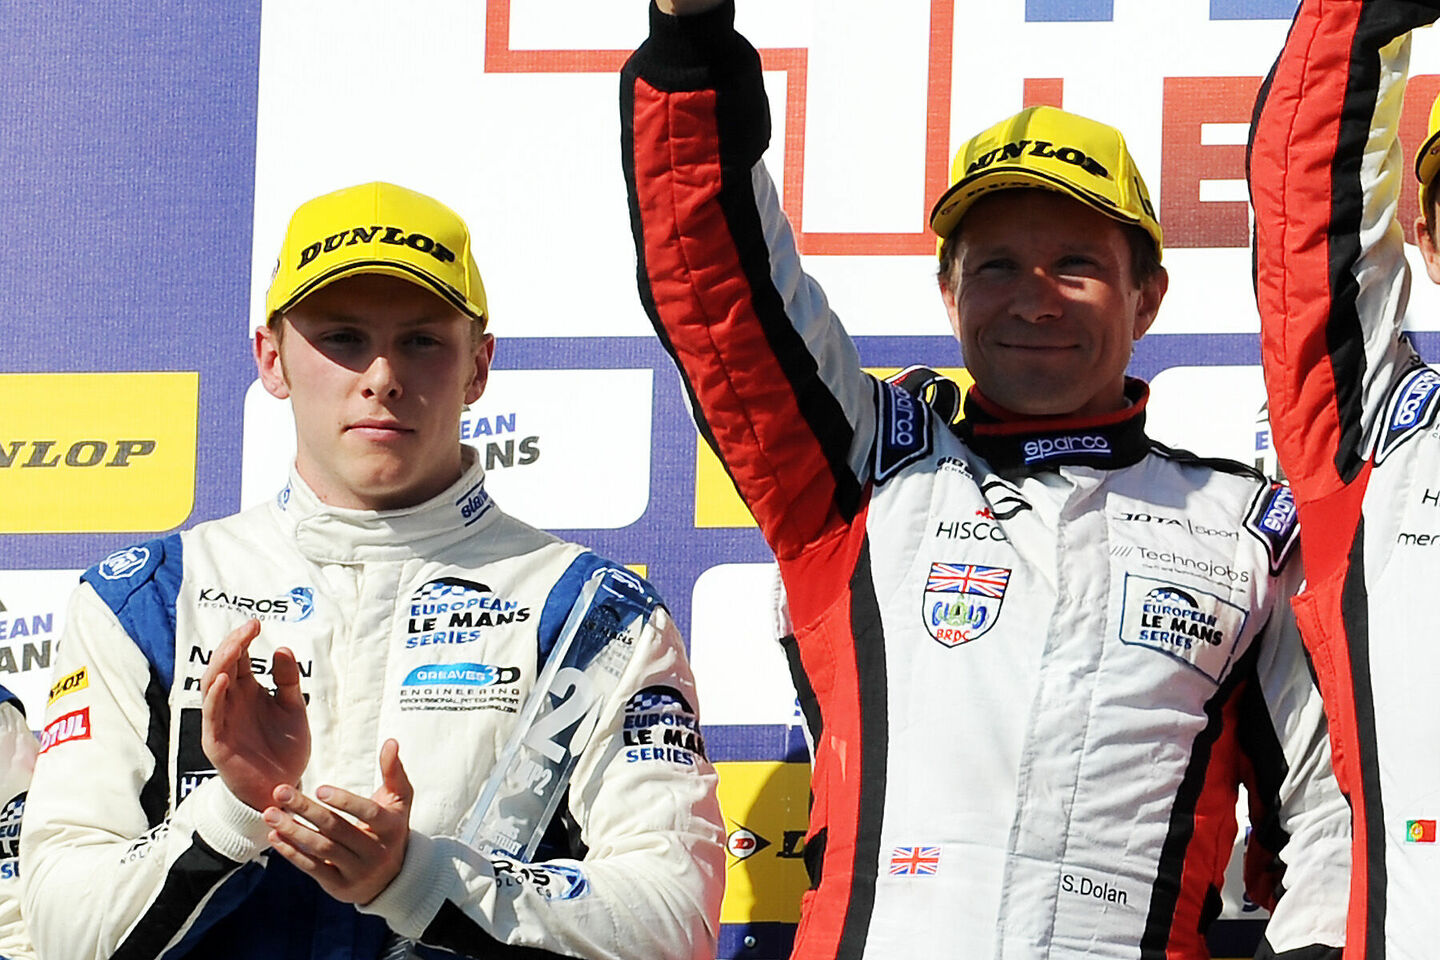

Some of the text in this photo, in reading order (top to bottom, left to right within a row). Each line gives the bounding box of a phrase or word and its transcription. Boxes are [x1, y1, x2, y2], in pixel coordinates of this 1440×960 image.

[965, 140, 1110, 178] DUNLOP
[297, 226, 456, 270] DUNLOP
[0, 441, 156, 468] NLOP
[486, 435, 540, 470] NS
[1023, 436, 1109, 459] sparco
[936, 521, 1010, 544] HISCO
[1137, 546, 1249, 583] Technojobs
[200, 589, 288, 613] KAIROS
[411, 597, 518, 617] EUROPEAN
[408, 607, 531, 634] LE MANS
[1143, 603, 1218, 628] EUROPEAN
[405, 630, 481, 649] SERIES
[936, 628, 971, 643] BRDC
[1139, 629, 1193, 649] SERIES
[1141, 614, 1223, 646] LE MANS
[417, 670, 485, 681] GREAVES
[400, 688, 520, 696] ENGINEERING
[522, 666, 596, 764] 2
[624, 713, 690, 729] EUROPE
[40, 714, 87, 752] OTUL
[623, 729, 652, 746] LE
[626, 748, 694, 765] SERIES
[1062, 874, 1127, 904] S.Dolan
